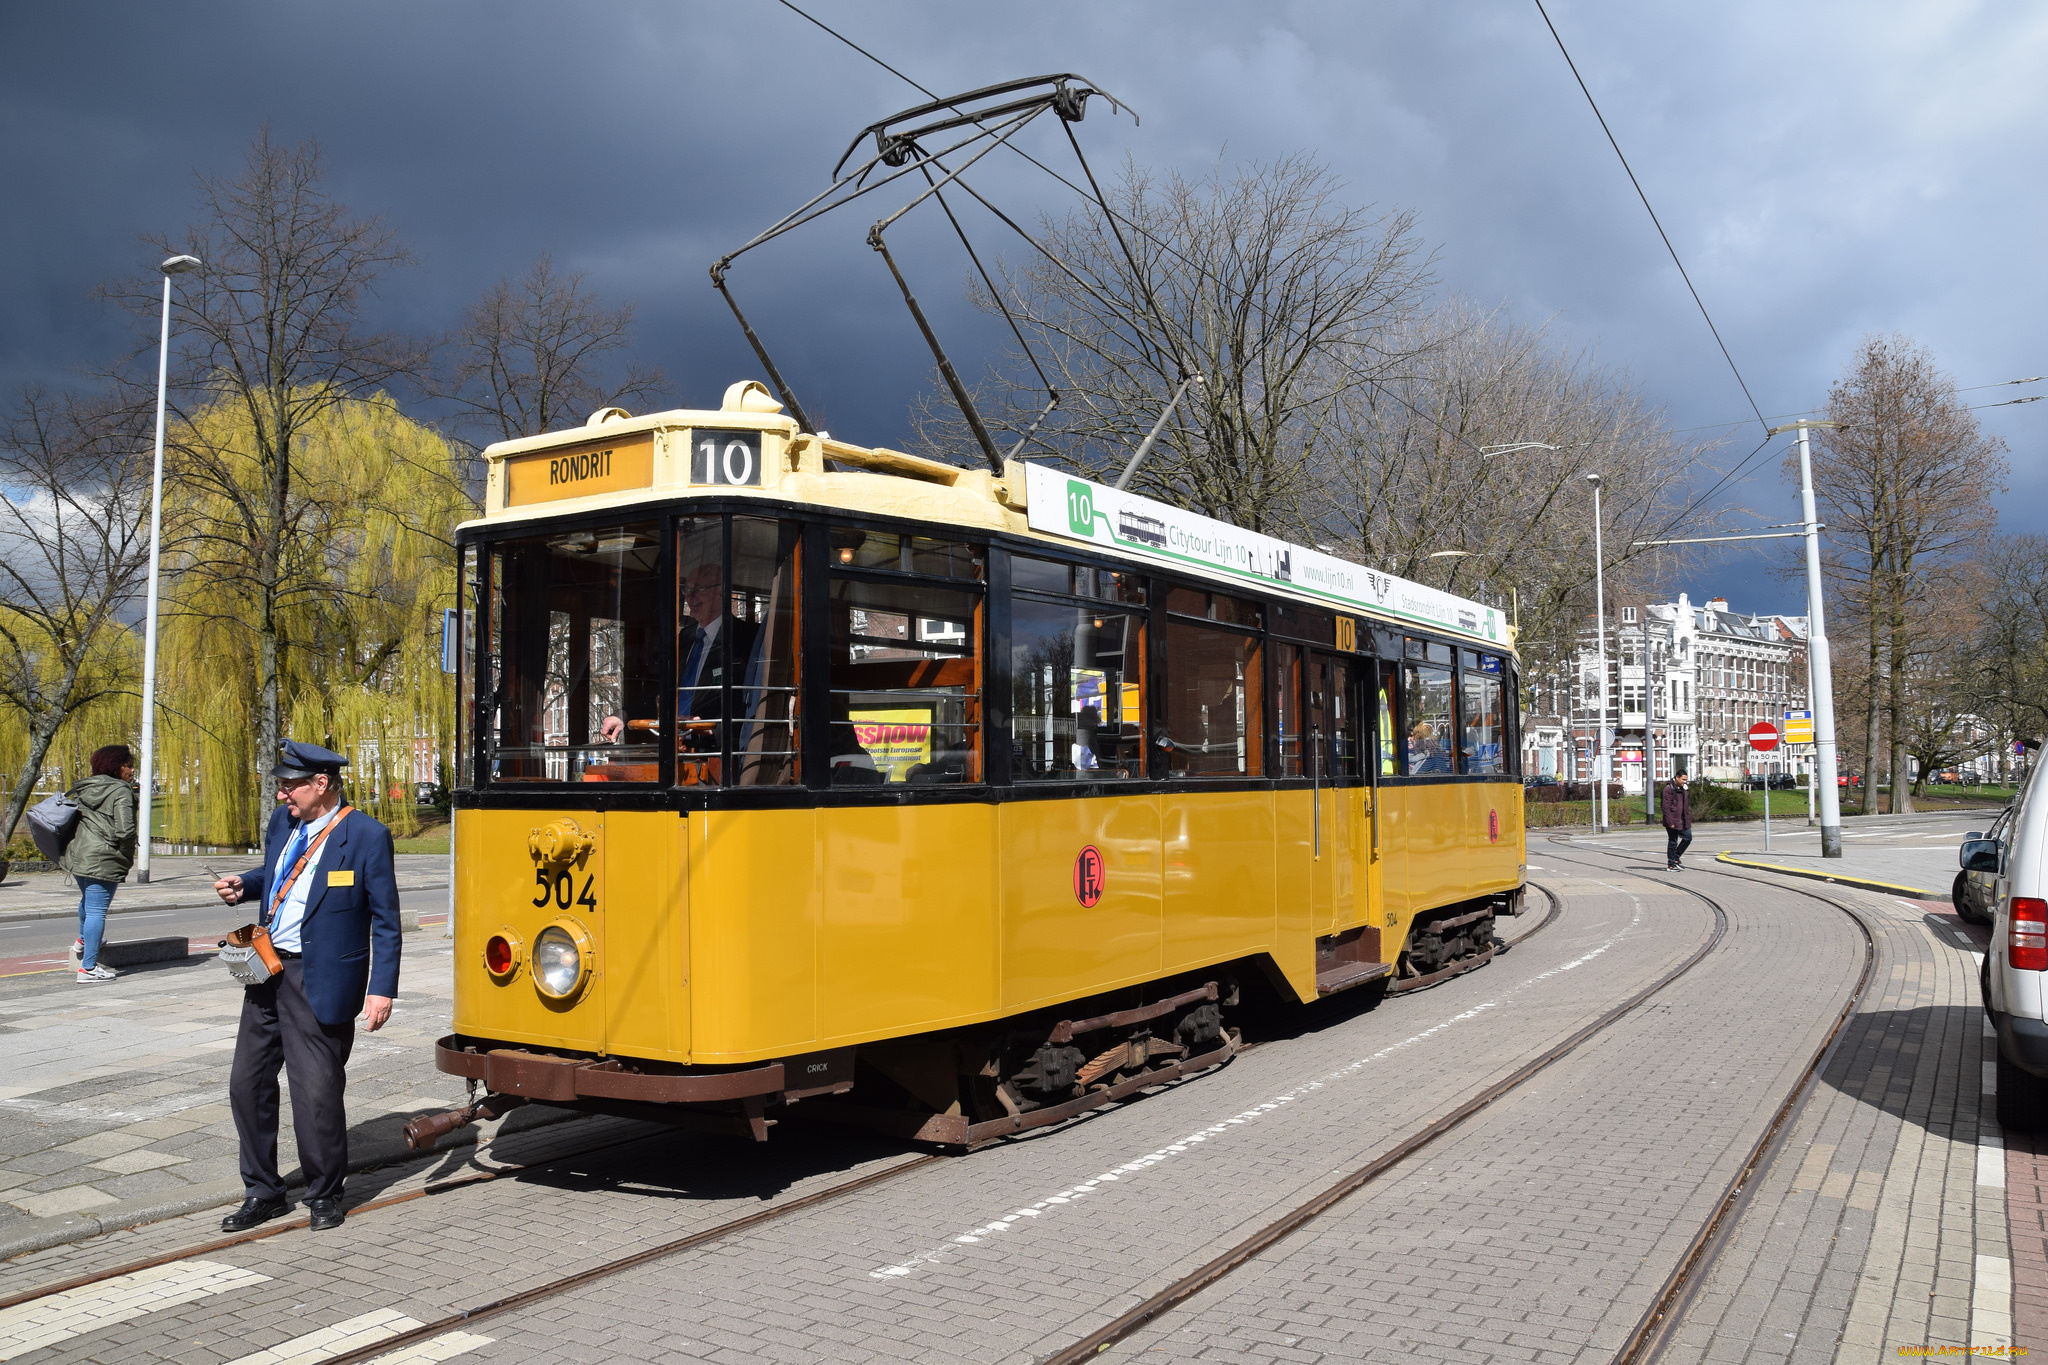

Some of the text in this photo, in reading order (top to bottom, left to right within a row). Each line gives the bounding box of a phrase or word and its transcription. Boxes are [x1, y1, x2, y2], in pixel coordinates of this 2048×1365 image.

[550, 450, 613, 485] RONDRIT
[700, 438, 752, 486] 10
[1069, 492, 1091, 525] 10
[1169, 525, 1247, 564] Citytour Lijn 10
[1304, 566, 1354, 591] www.lijn10.nl
[1340, 619, 1351, 650] 10
[1488, 615, 1495, 634] 10
[532, 868, 597, 913] 504
[1387, 912, 1398, 928] 504
[807, 1062, 828, 1074] CRICK
